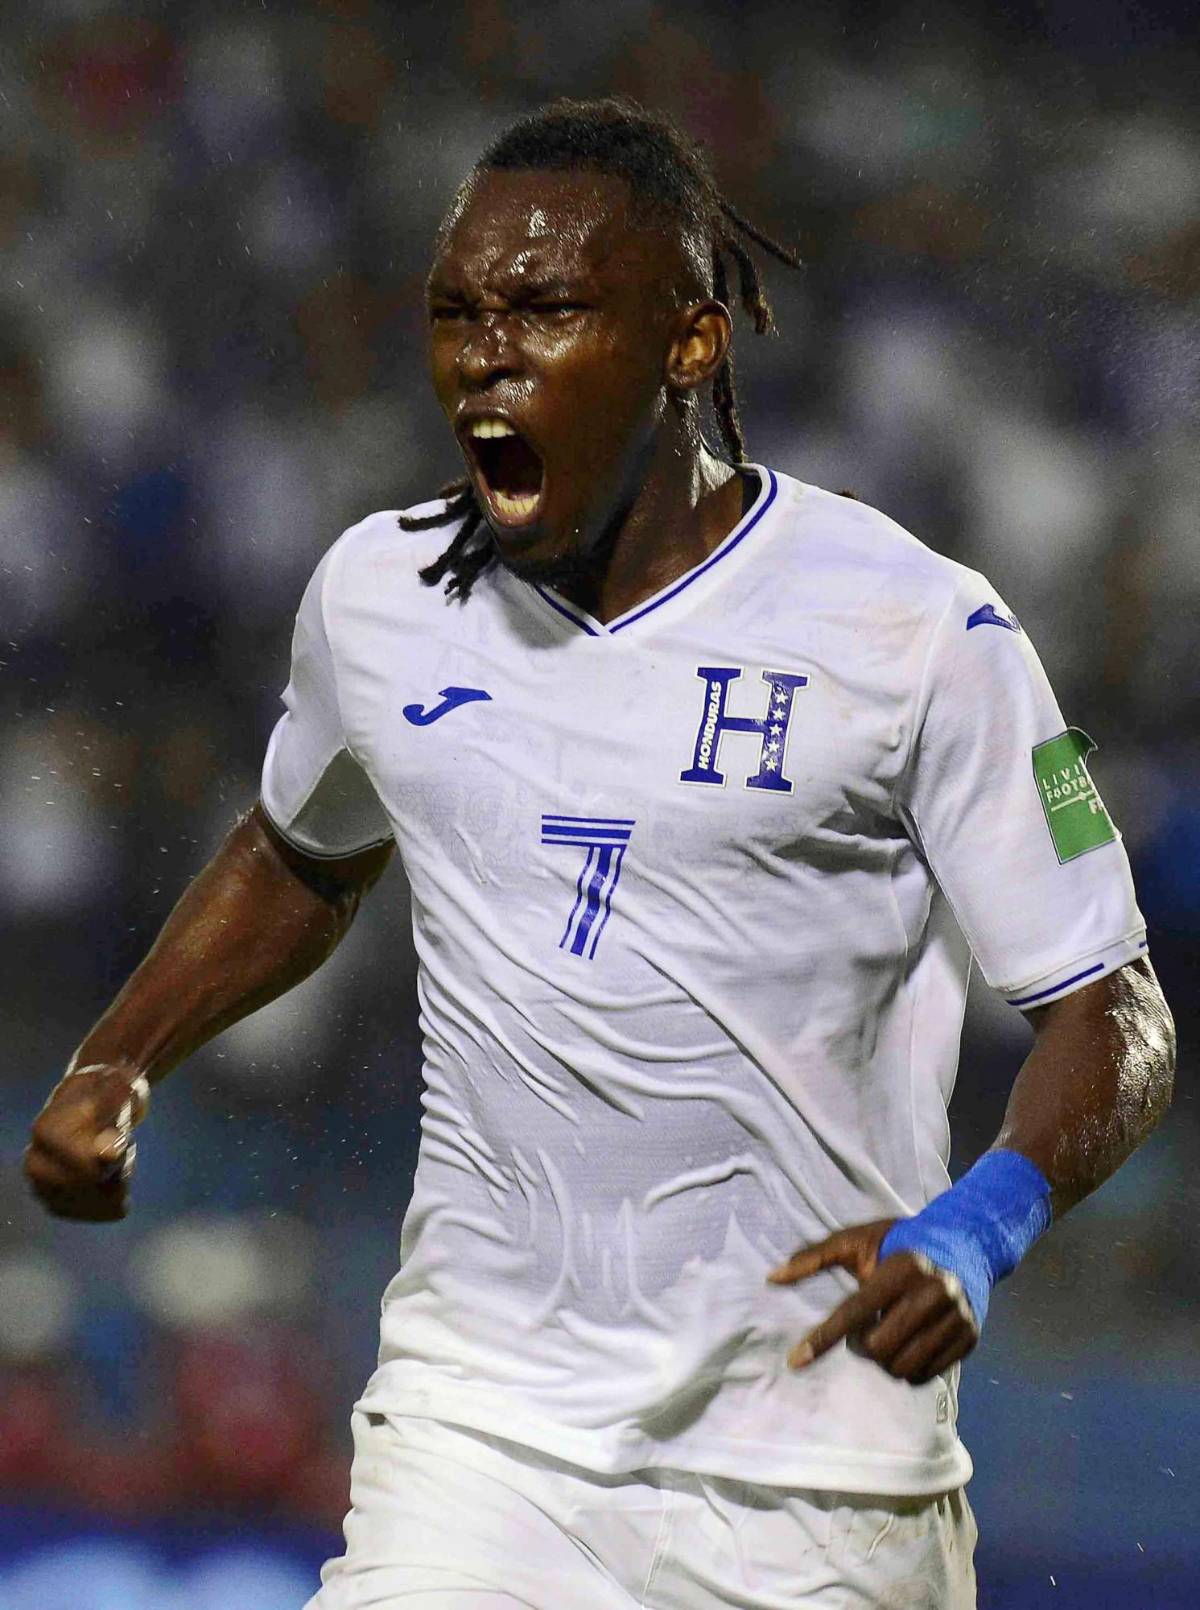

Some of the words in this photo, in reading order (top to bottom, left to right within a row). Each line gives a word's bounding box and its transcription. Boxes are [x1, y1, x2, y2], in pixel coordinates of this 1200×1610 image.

[679, 665, 810, 794] H
[698, 681, 722, 770] HONDURAS
[1043, 763, 1082, 791] LIVI
[1046, 775, 1092, 804] FOOTB
[541, 815, 636, 960] 7
